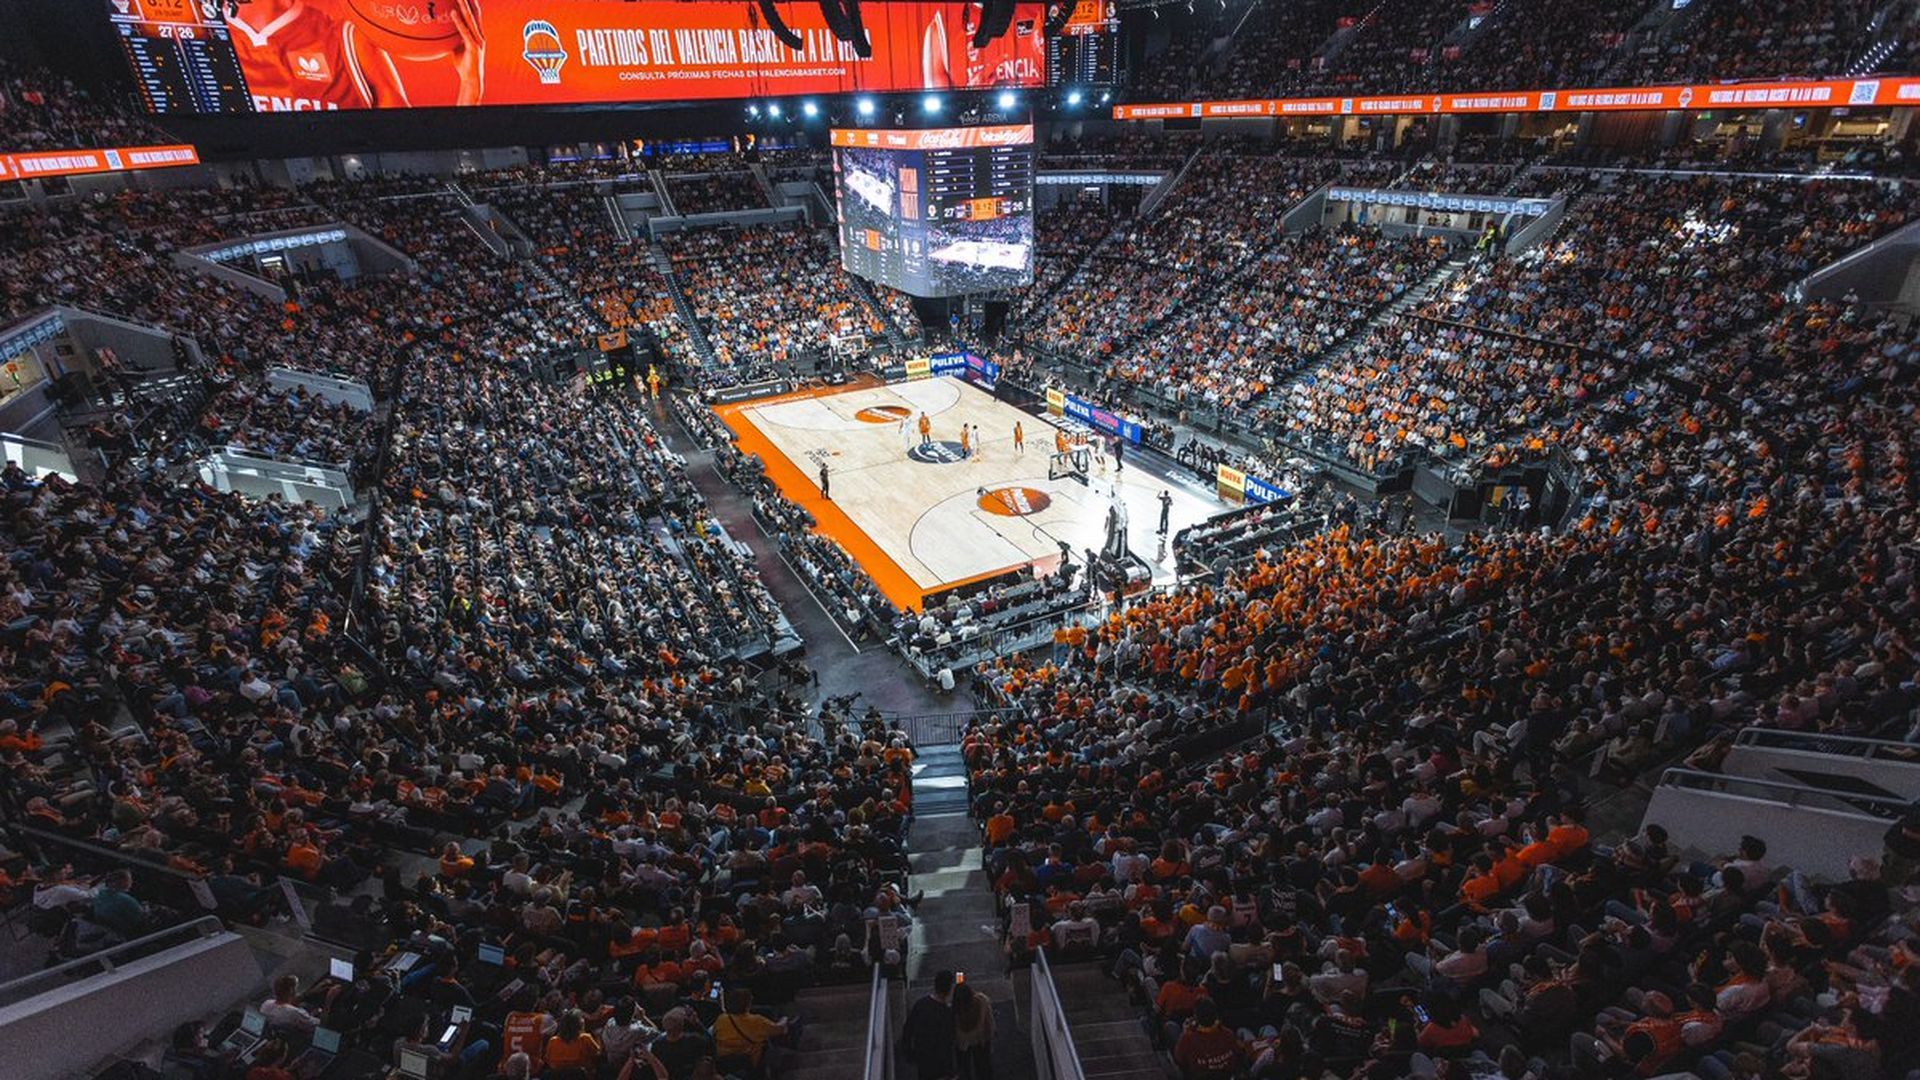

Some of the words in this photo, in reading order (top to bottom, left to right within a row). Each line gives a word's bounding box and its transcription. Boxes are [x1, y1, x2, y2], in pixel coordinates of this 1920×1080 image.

[158, 25, 172, 37] 27
[576, 29, 649, 66] PARTIDOS
[650, 29, 675, 65] DEL
[675, 29, 735, 64] VALENCIA
[739, 29, 785, 63] BASKET
[808, 29, 817, 62] A
[819, 29, 834, 62] LA
[836, 29, 873, 61] VEN
[619, 70, 665, 80] CONSULTA
[666, 68, 711, 80] PRÓXIMAS
[712, 69, 744, 79] FECHAS
[746, 69, 758, 78] EN
[759, 68, 846, 77] VALENCIABASKET.COM
[943, 207, 954, 218] 27
[931, 355, 965, 367] PULEVA
[1246, 478, 1282, 501] PULEV
